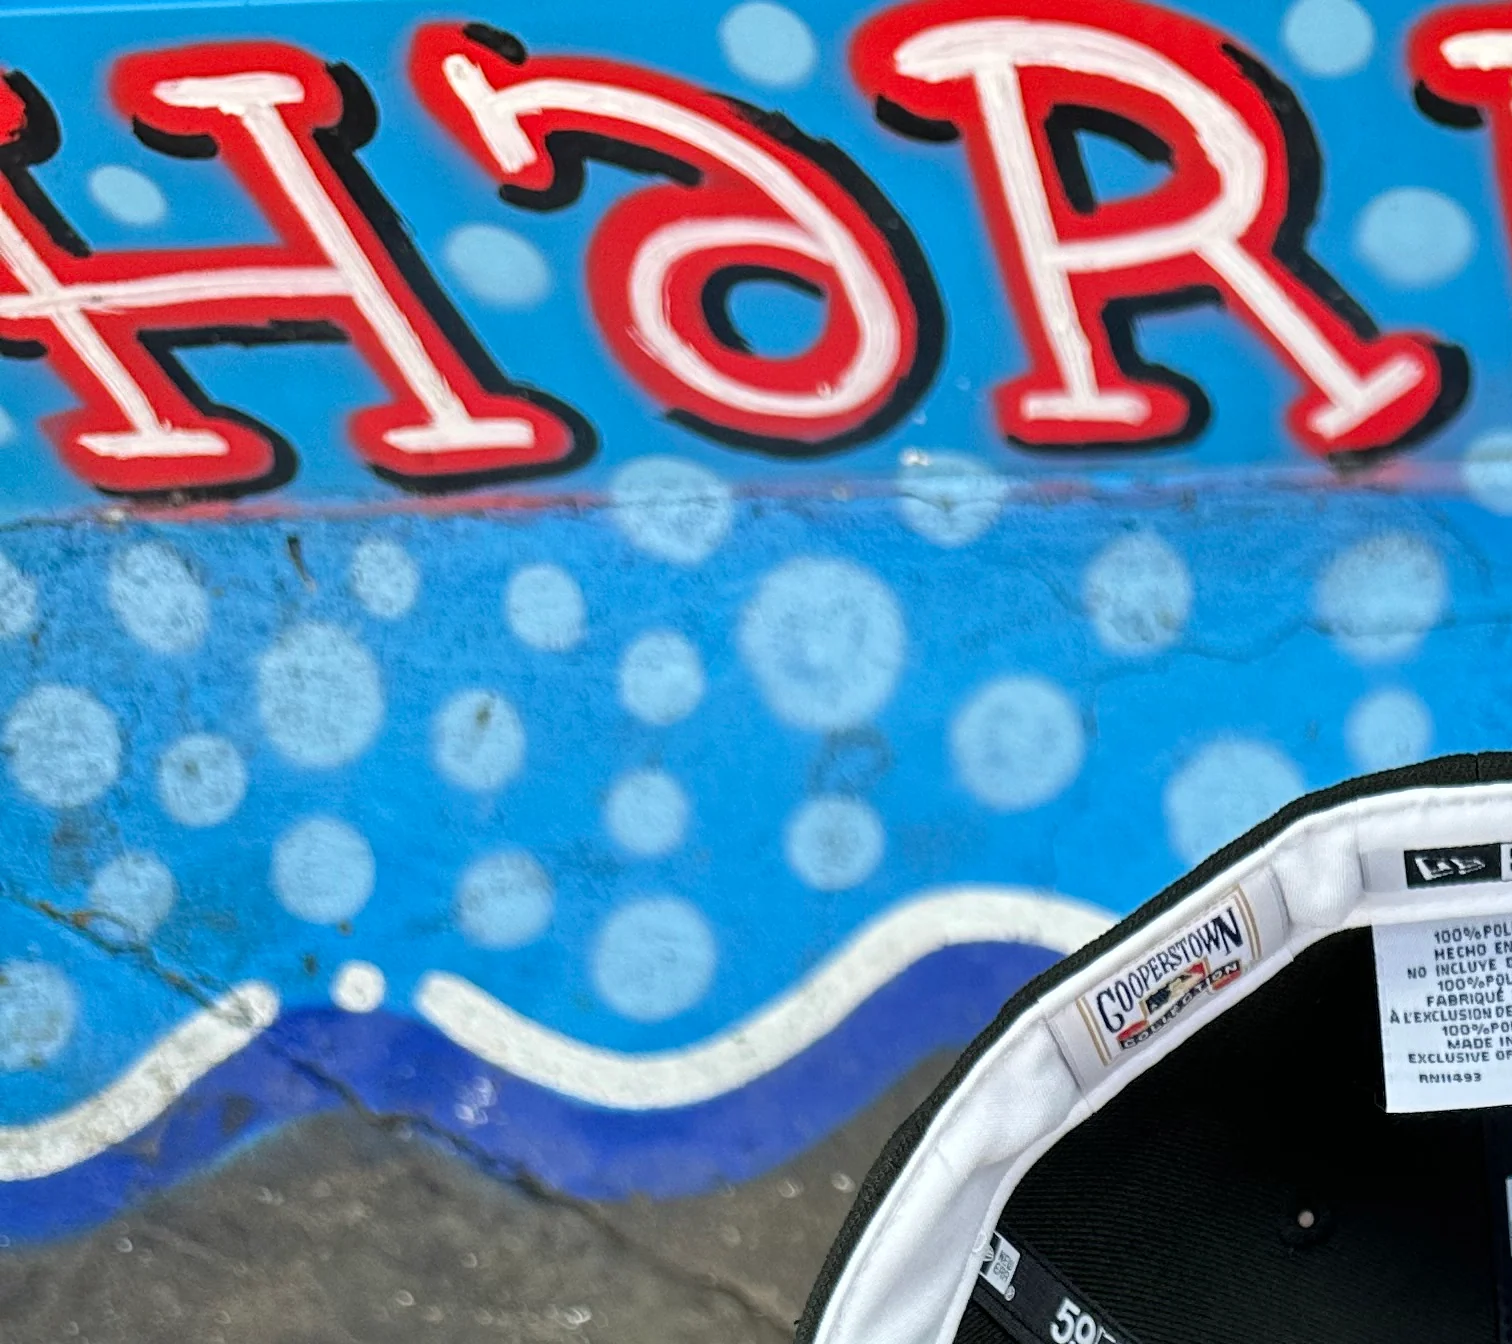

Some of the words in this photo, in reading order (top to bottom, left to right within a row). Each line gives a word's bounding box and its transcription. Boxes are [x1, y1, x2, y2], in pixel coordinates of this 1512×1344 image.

[1434, 944, 1487, 961] HECHO
[1095, 906, 1244, 1034] COOPERSTOWN
[1407, 967, 1427, 980] NO
[1436, 959, 1498, 977] INCLUYE
[1426, 987, 1503, 1007] FABRIQUÉ
[1390, 1007, 1400, 1024] À
[1403, 1007, 1492, 1024] L'EXCLUSION
[1447, 1036, 1493, 1050] MADE
[1408, 1051, 1491, 1064] EXCLUSIVE
